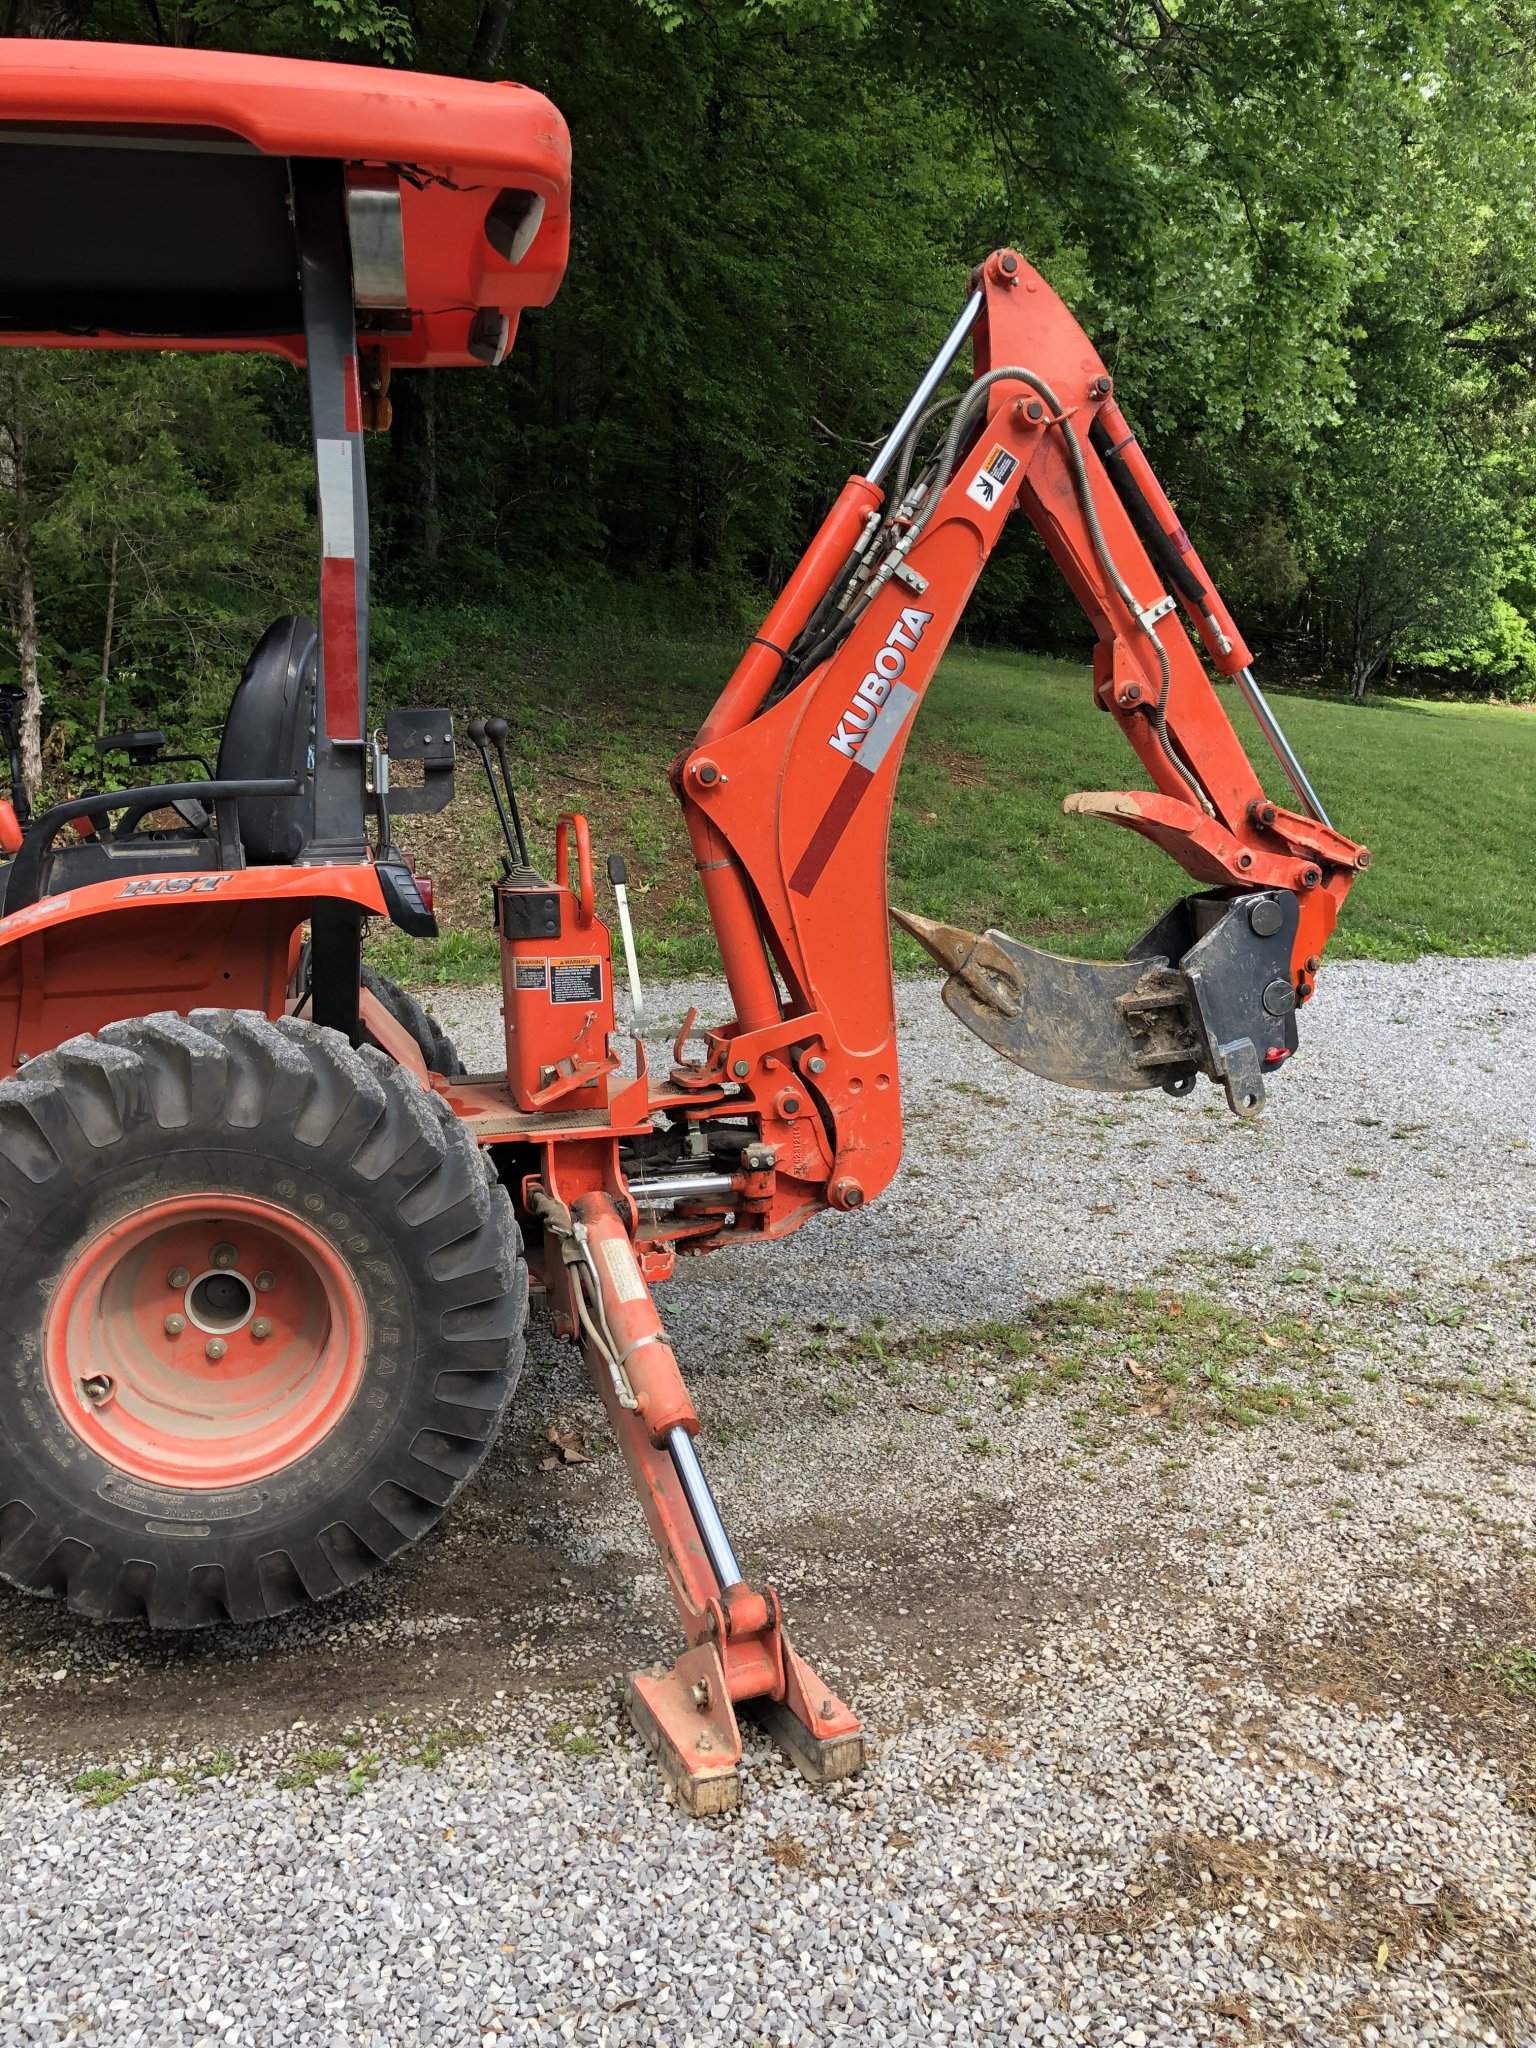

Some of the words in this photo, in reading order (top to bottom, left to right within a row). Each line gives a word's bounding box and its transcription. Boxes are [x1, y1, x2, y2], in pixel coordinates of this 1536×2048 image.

[827, 607, 934, 759] KUBOTA
[114, 874, 234, 899] HST
[277, 1180, 399, 1409] GOODYEAR
[163, 1508, 203, 1519] RATING
[211, 1507, 231, 1519] PLY
